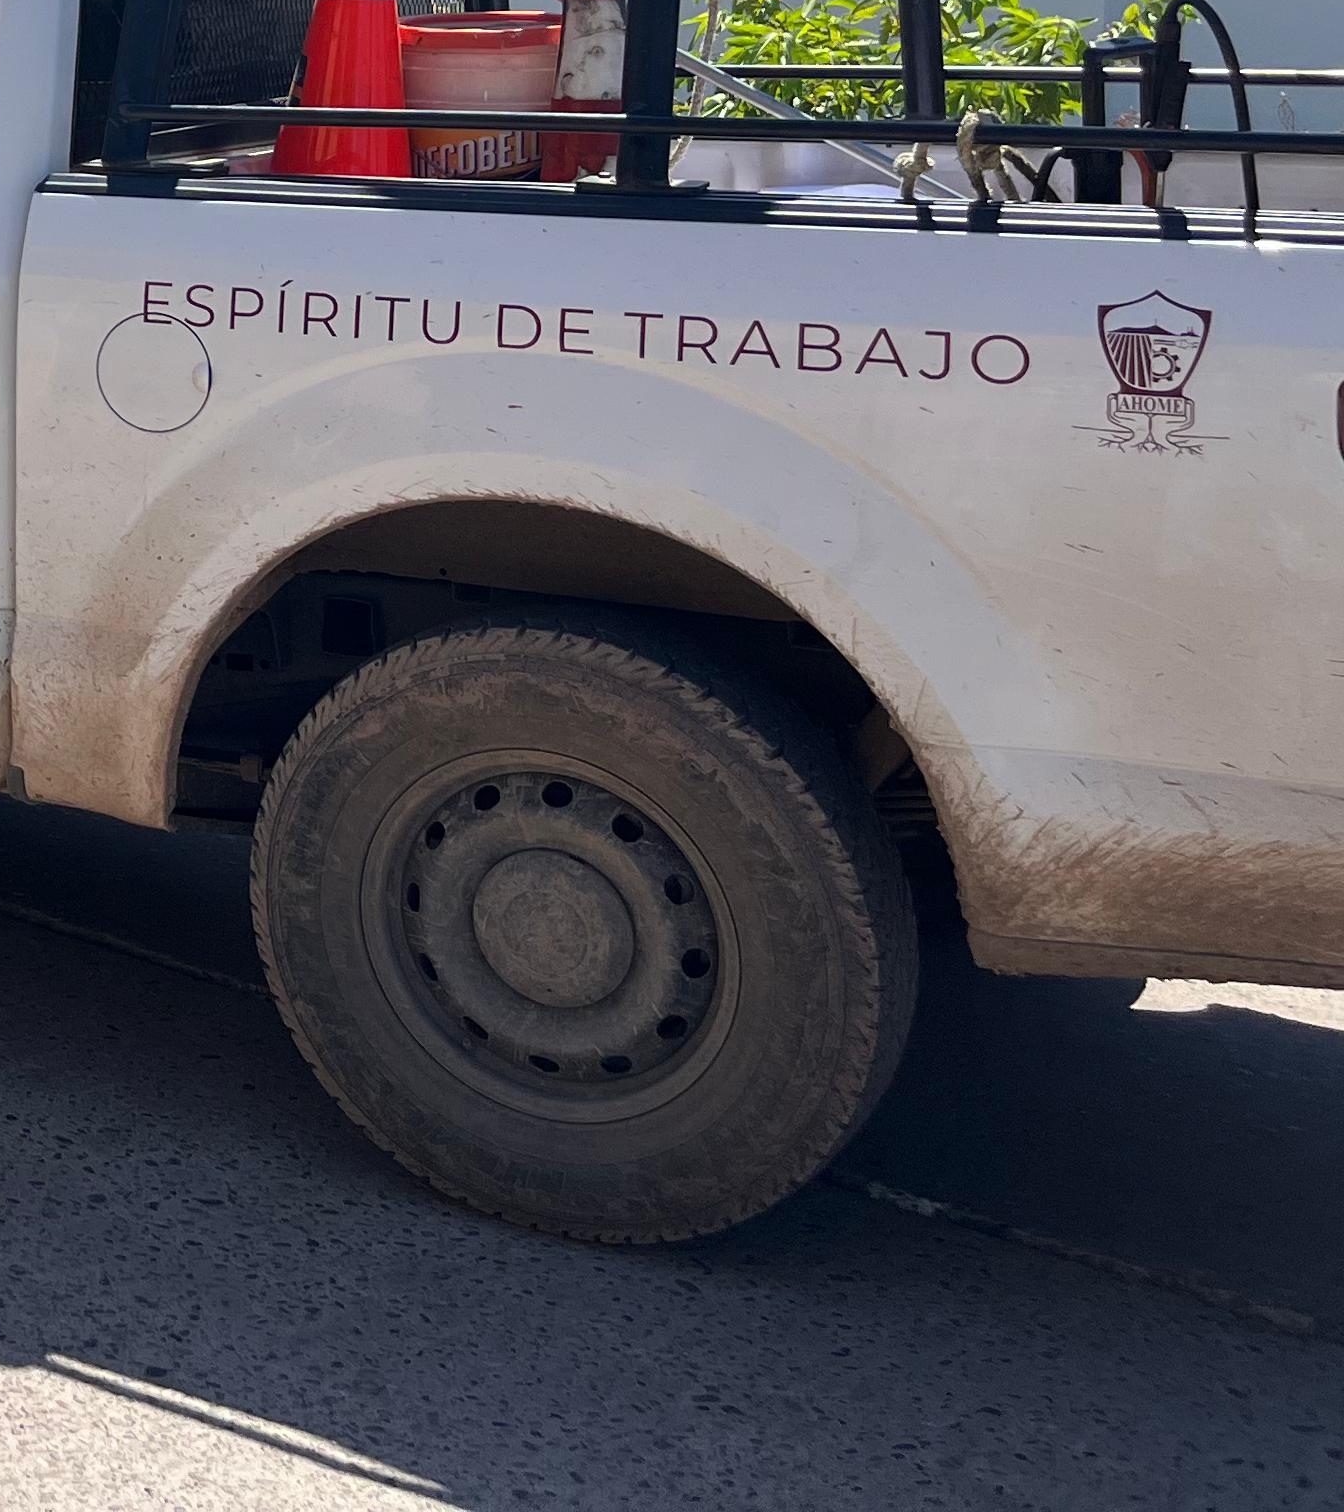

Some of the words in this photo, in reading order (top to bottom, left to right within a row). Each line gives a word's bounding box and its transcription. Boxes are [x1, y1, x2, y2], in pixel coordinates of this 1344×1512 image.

[142, 279, 461, 345] ESPÍRITU
[496, 303, 595, 354] DE
[623, 311, 1031, 385] TRABAJO
[1119, 396, 1183, 413] AHOME
